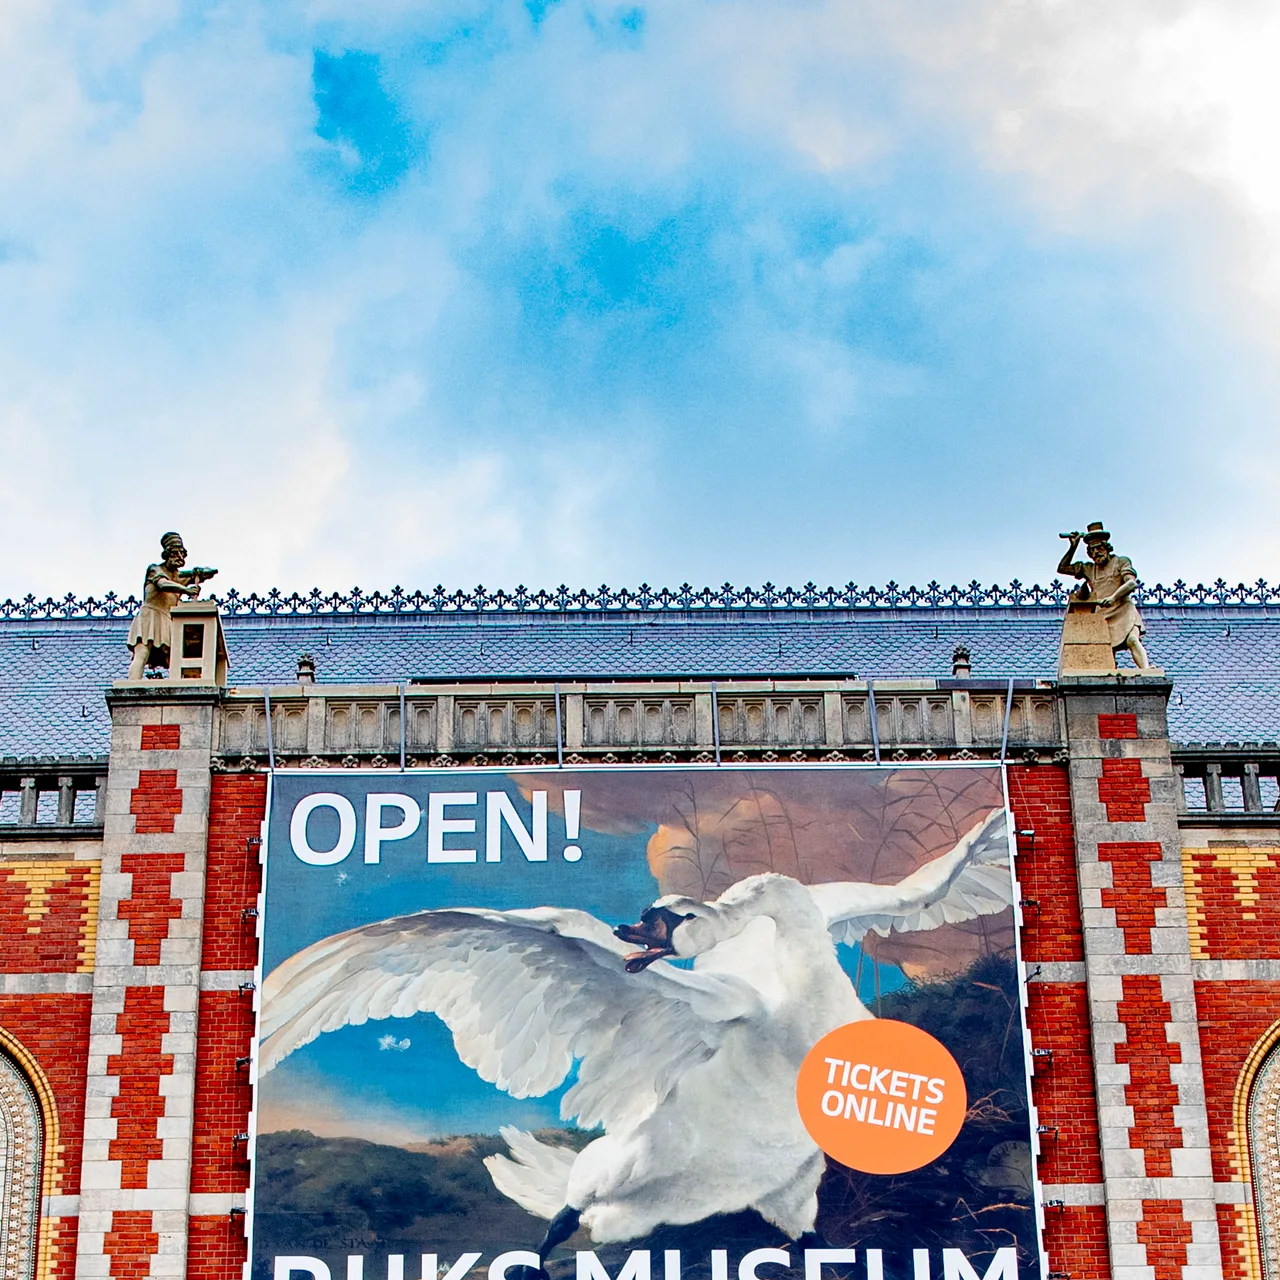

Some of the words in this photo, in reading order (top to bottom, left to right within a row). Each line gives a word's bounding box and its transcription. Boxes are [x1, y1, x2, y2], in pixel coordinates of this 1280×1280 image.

[289, 789, 583, 866] OPEN!
[824, 1056, 946, 1104] TICKETS
[821, 1090, 938, 1136] ONLINE
